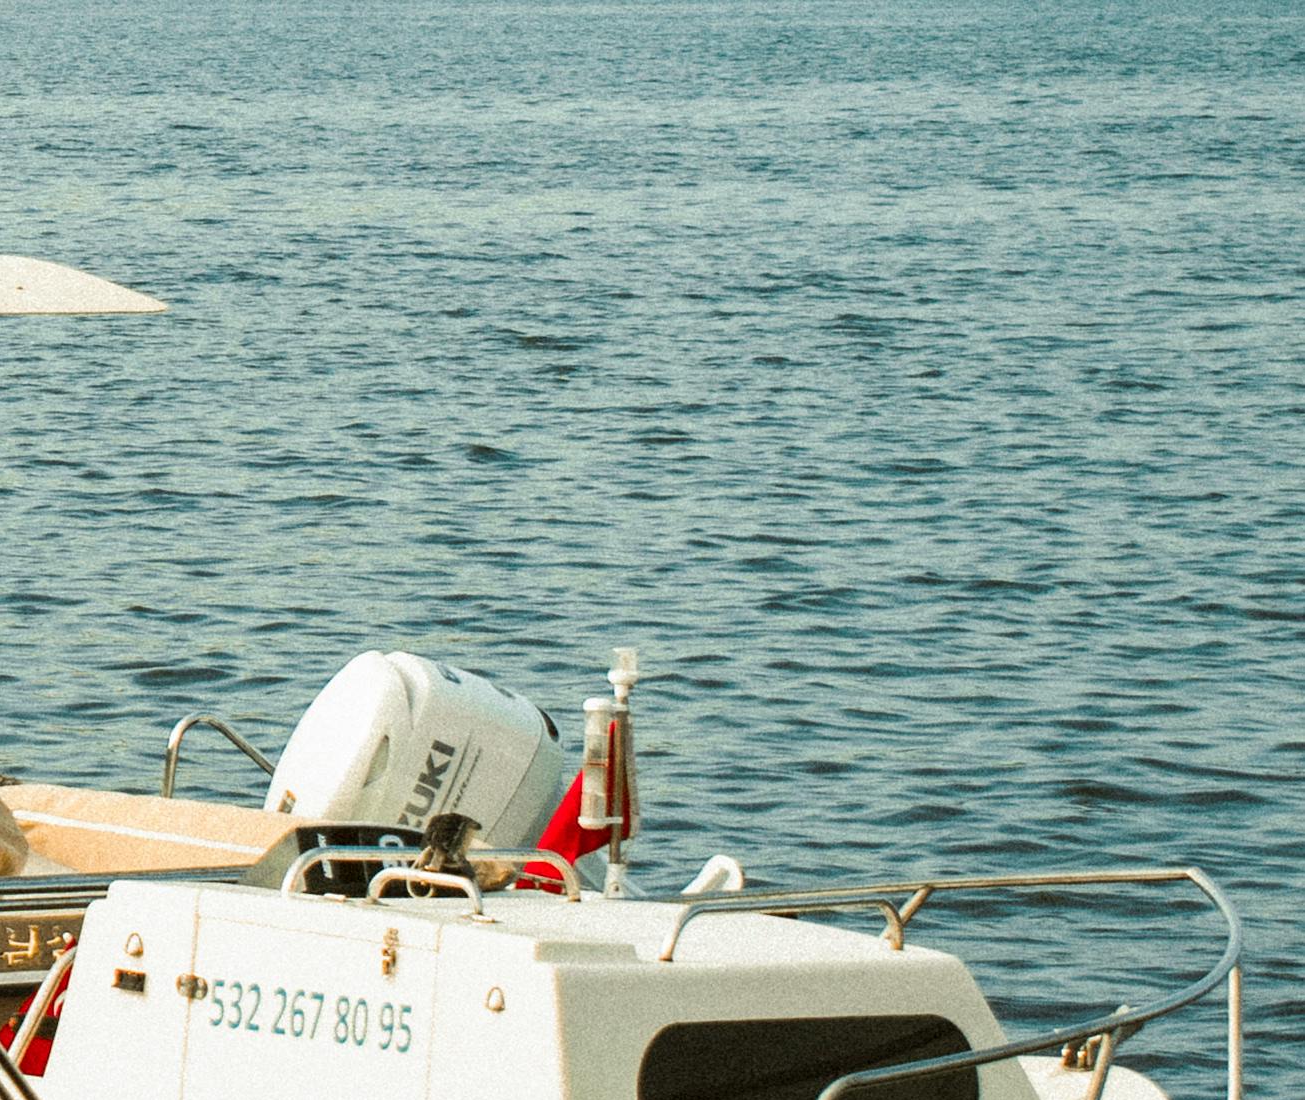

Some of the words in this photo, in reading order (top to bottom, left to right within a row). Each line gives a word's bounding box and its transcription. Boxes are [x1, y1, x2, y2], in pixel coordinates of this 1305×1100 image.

[396, 739, 456, 828] UKI
[209, 979, 261, 1032] 532
[271, 987, 325, 1040] 267
[334, 995, 369, 1047] 80
[379, 1002, 412, 1053] 95
